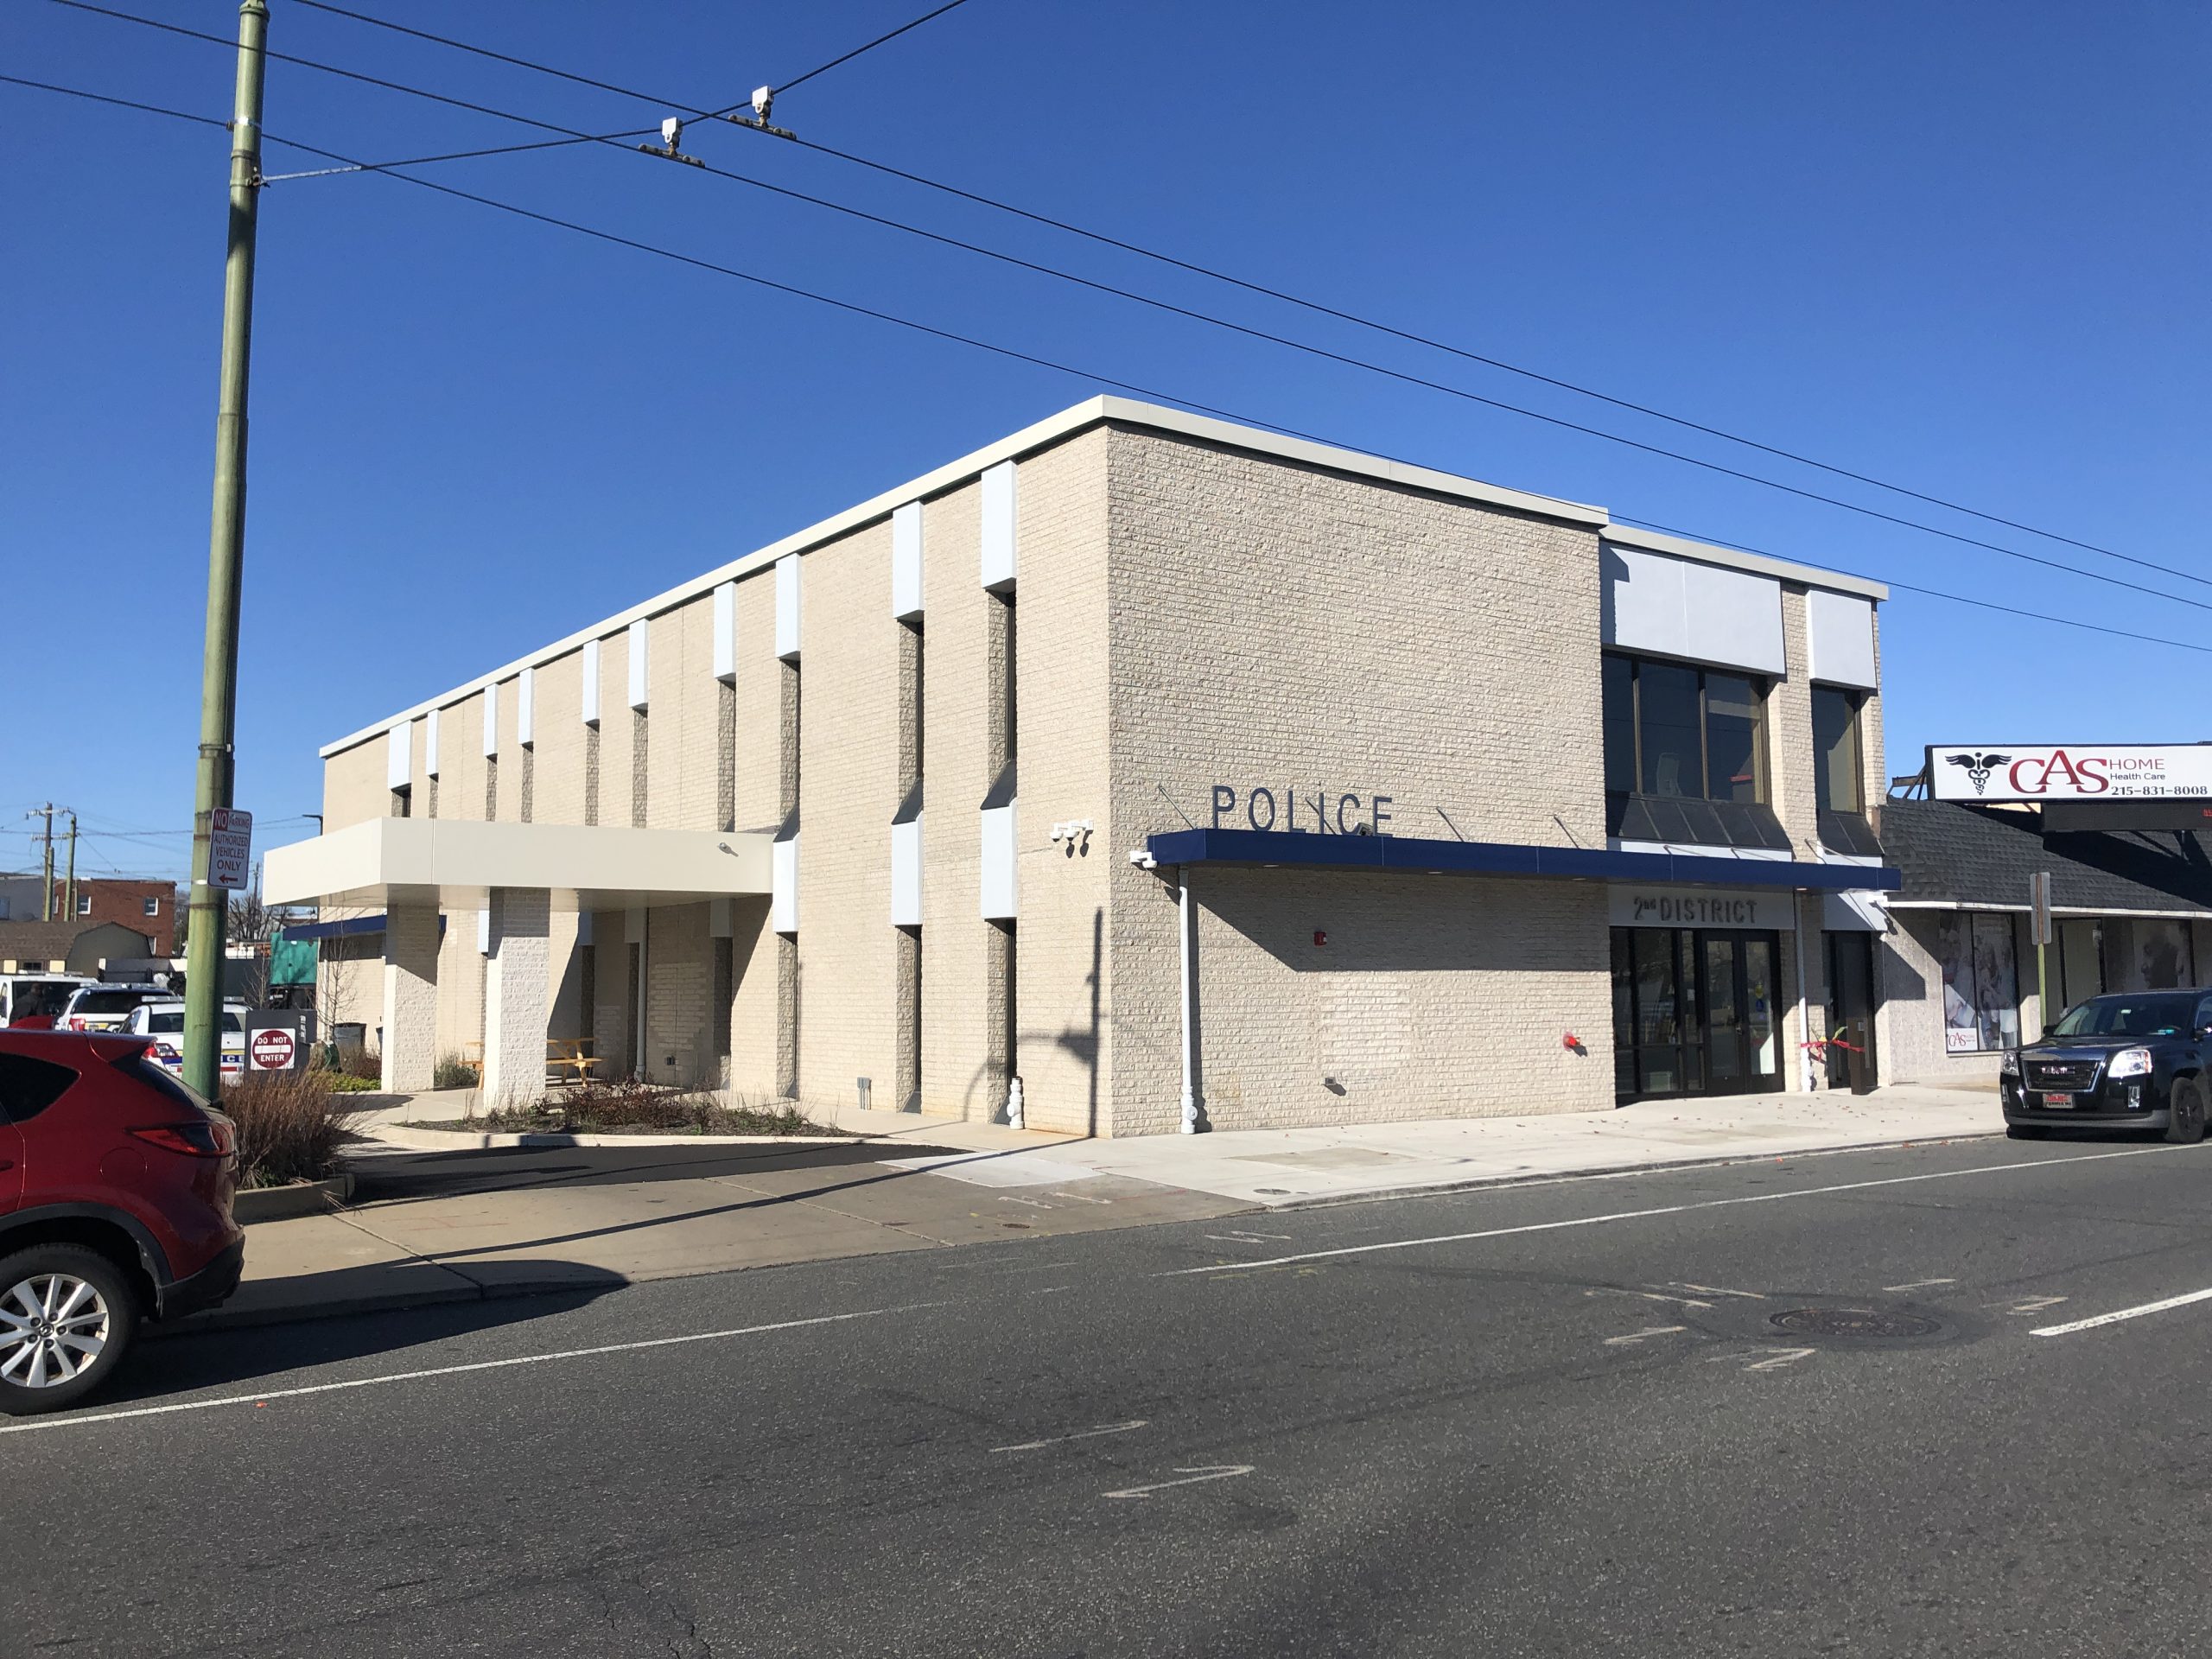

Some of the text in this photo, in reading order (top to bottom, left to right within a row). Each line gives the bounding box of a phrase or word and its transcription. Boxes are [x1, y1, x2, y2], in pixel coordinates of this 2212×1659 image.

[2009, 749, 2109, 794] CAS
[2109, 758, 2165, 771] HOME
[2111, 785, 2209, 796] 215-831-8008
[1212, 785, 1394, 838] POLICE
[214, 812, 227, 829] NO
[213, 833, 249, 847] AUTHORIZED
[215, 846, 245, 859] VEHICLES
[217, 860, 241, 871] ONLY
[1633, 896, 1758, 924] 2nd DISTRICT
[257, 1036, 288, 1045] DO NOT
[1948, 1032, 1967, 1047] CAS
